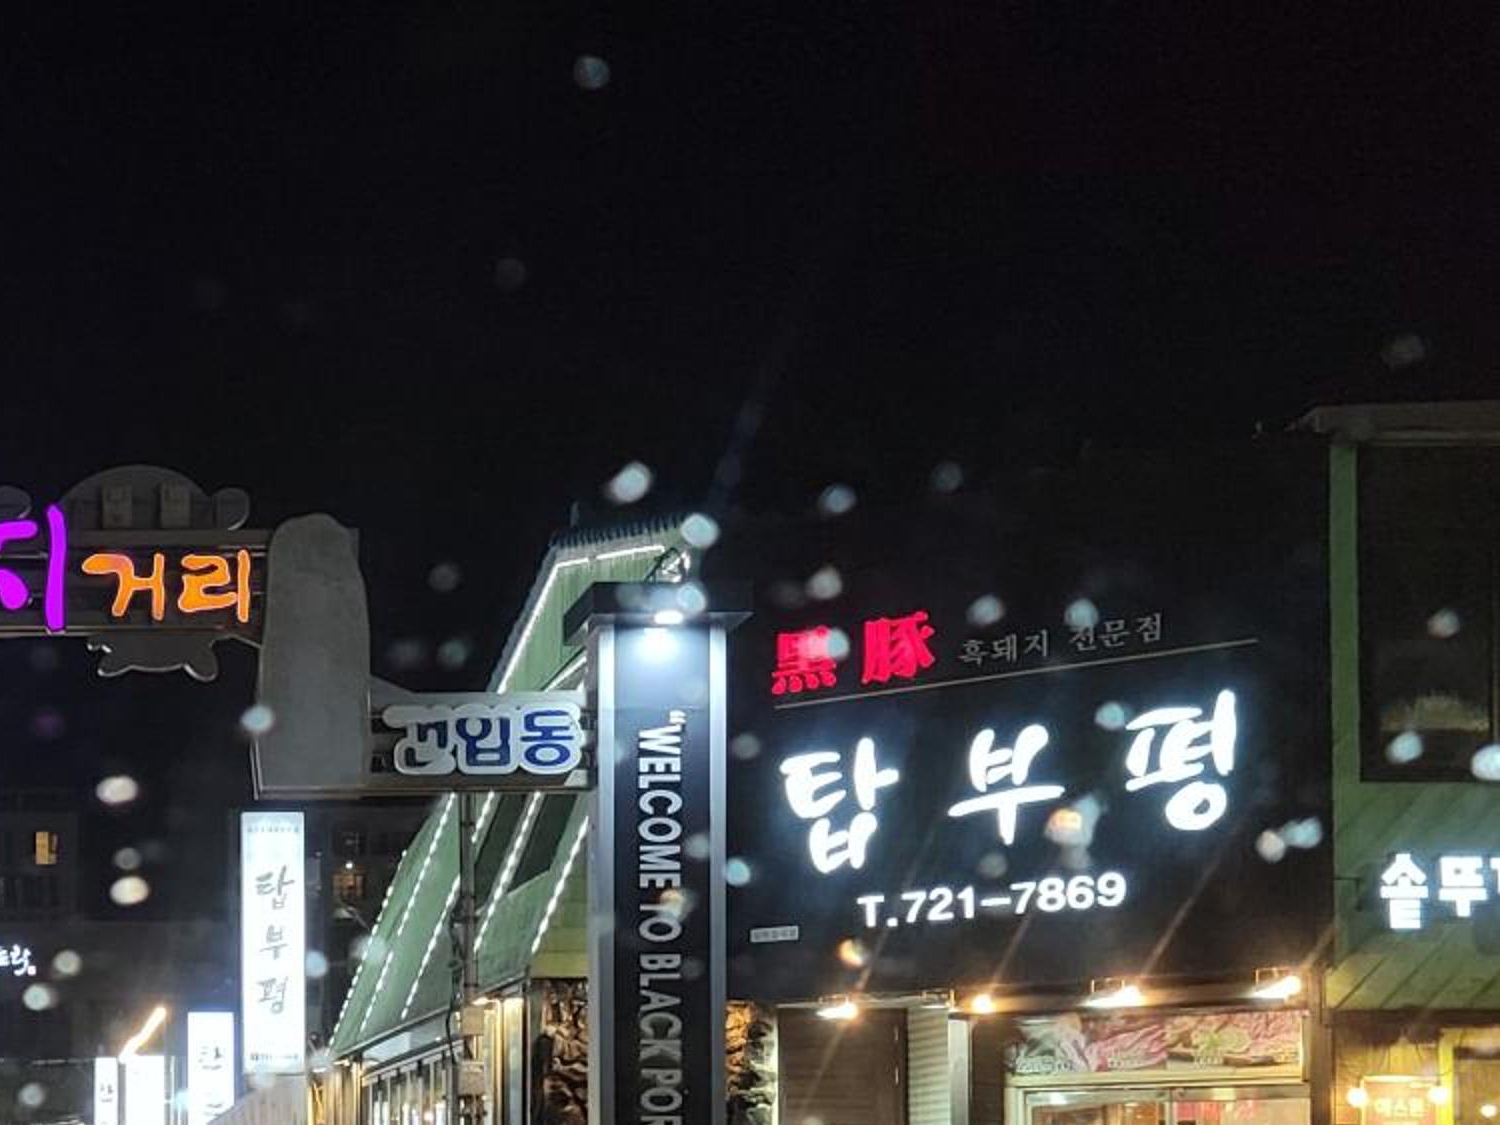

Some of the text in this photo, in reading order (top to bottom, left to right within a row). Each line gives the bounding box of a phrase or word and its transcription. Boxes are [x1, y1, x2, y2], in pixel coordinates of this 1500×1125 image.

[82, 550, 251, 623] 거리
[959, 612, 1162, 667] 흑돼지 전문점
[638, 896, 684, 942] TO
[638, 953, 684, 1062] BLACK
